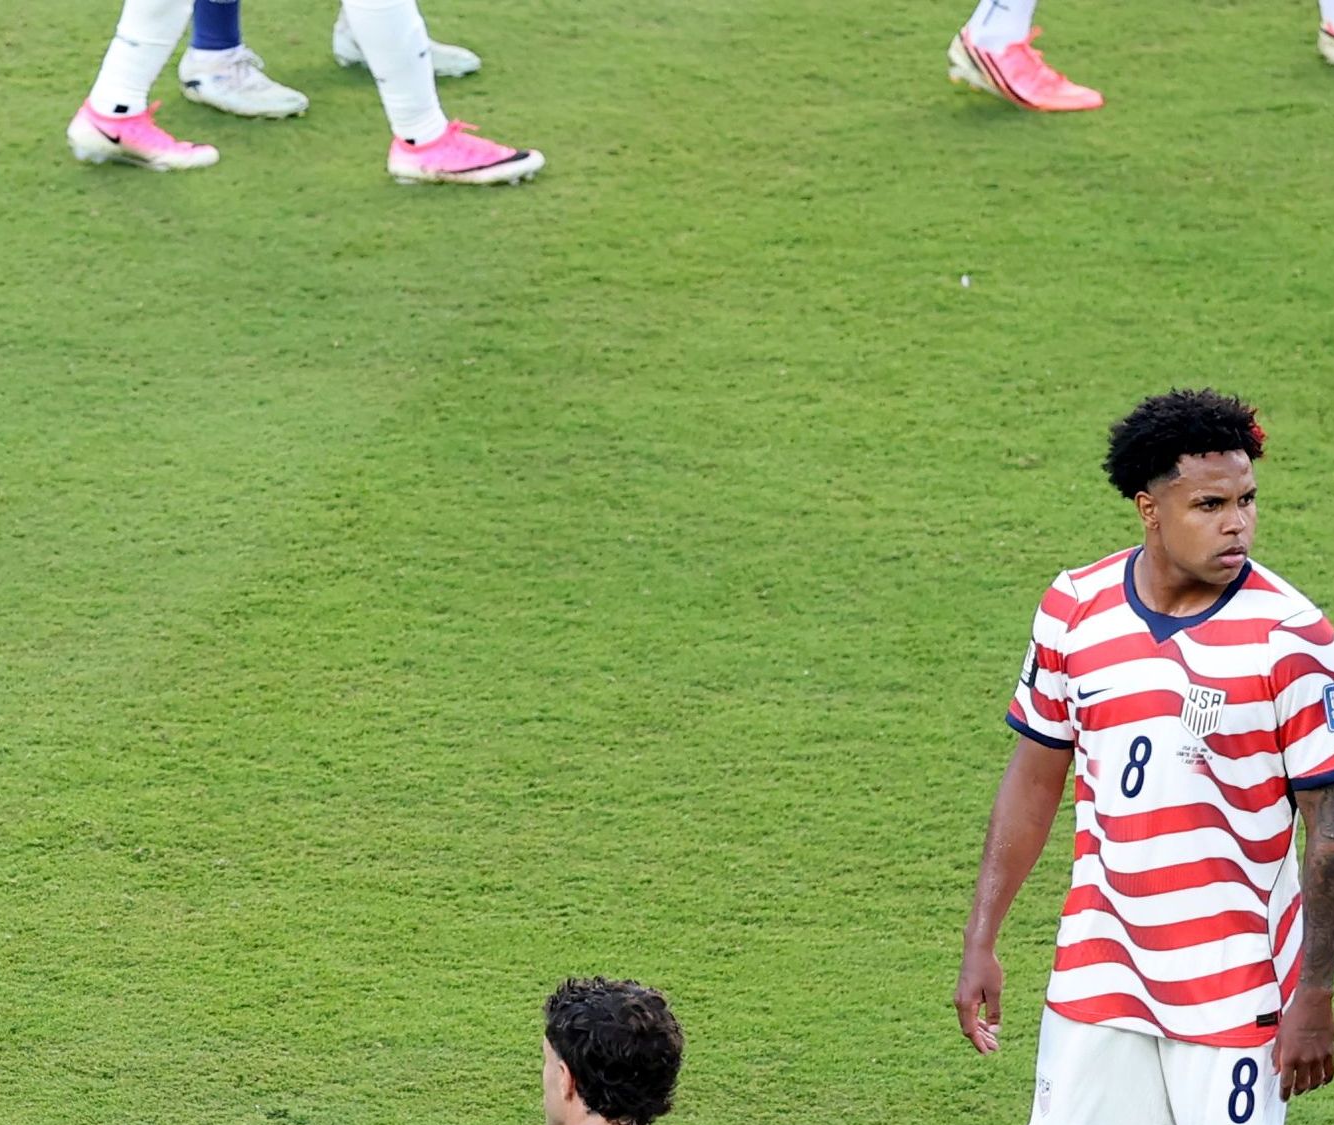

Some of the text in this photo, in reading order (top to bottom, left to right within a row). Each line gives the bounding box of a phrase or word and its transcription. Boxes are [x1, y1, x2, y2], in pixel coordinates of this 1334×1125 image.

[1188, 687, 1222, 710] USA
[1121, 735, 1152, 799] 8
[1228, 1057, 1258, 1124] 8
